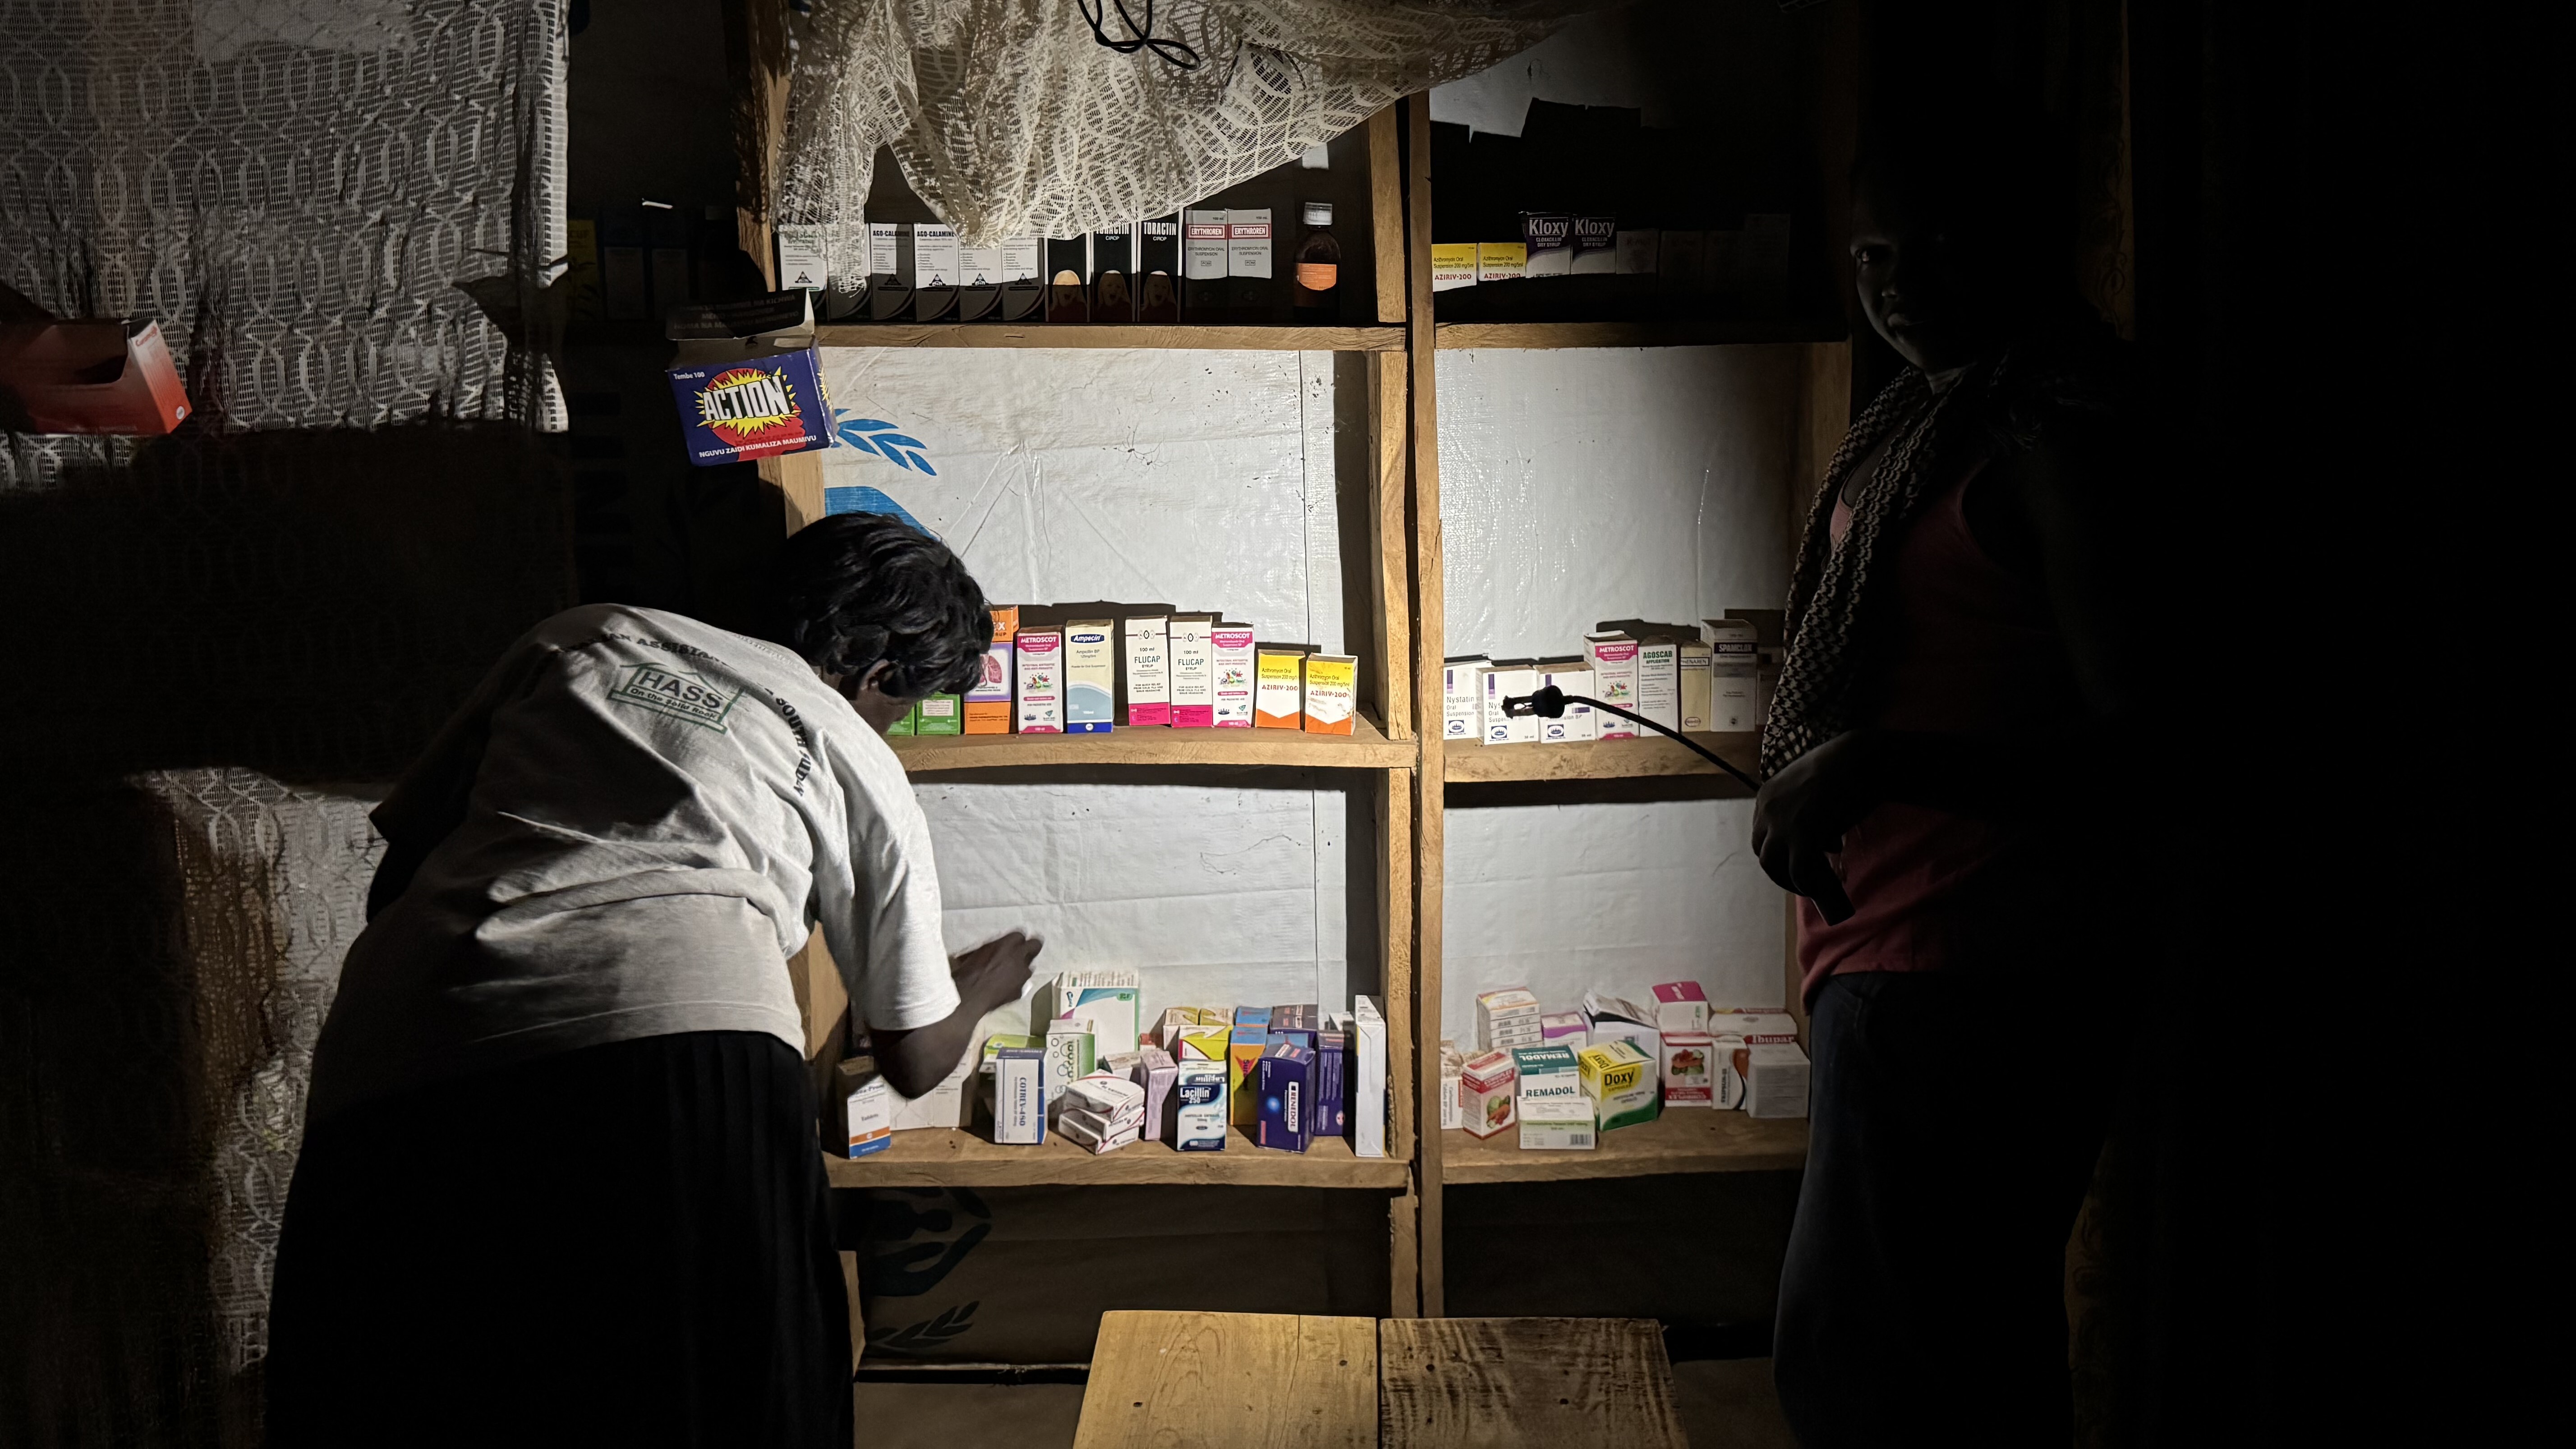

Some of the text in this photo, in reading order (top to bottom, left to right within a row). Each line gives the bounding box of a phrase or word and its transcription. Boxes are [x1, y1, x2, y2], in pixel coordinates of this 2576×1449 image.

[1144, 222, 1176, 235] TORACTIN
[1529, 219, 1568, 237] Kloxy
[1575, 219, 1615, 237] Kloxy
[703, 375, 790, 420] ACTION
[699, 448, 725, 458] NGUVU
[725, 445, 745, 454] ZAIDI
[745, 441, 782, 451] KUMALIZA
[782, 435, 817, 445] MAUMIVU
[1643, 651, 1673, 659] AGOSCAB
[639, 672, 723, 709] HASS
[630, 688, 717, 719] On the Solid Rock
[1519, 1053, 1570, 1061] REMADOL
[1605, 1071, 1634, 1086] Doxy
[1180, 1087, 1210, 1098] Lacillin
[1526, 1086, 1575, 1097] REMADOL
